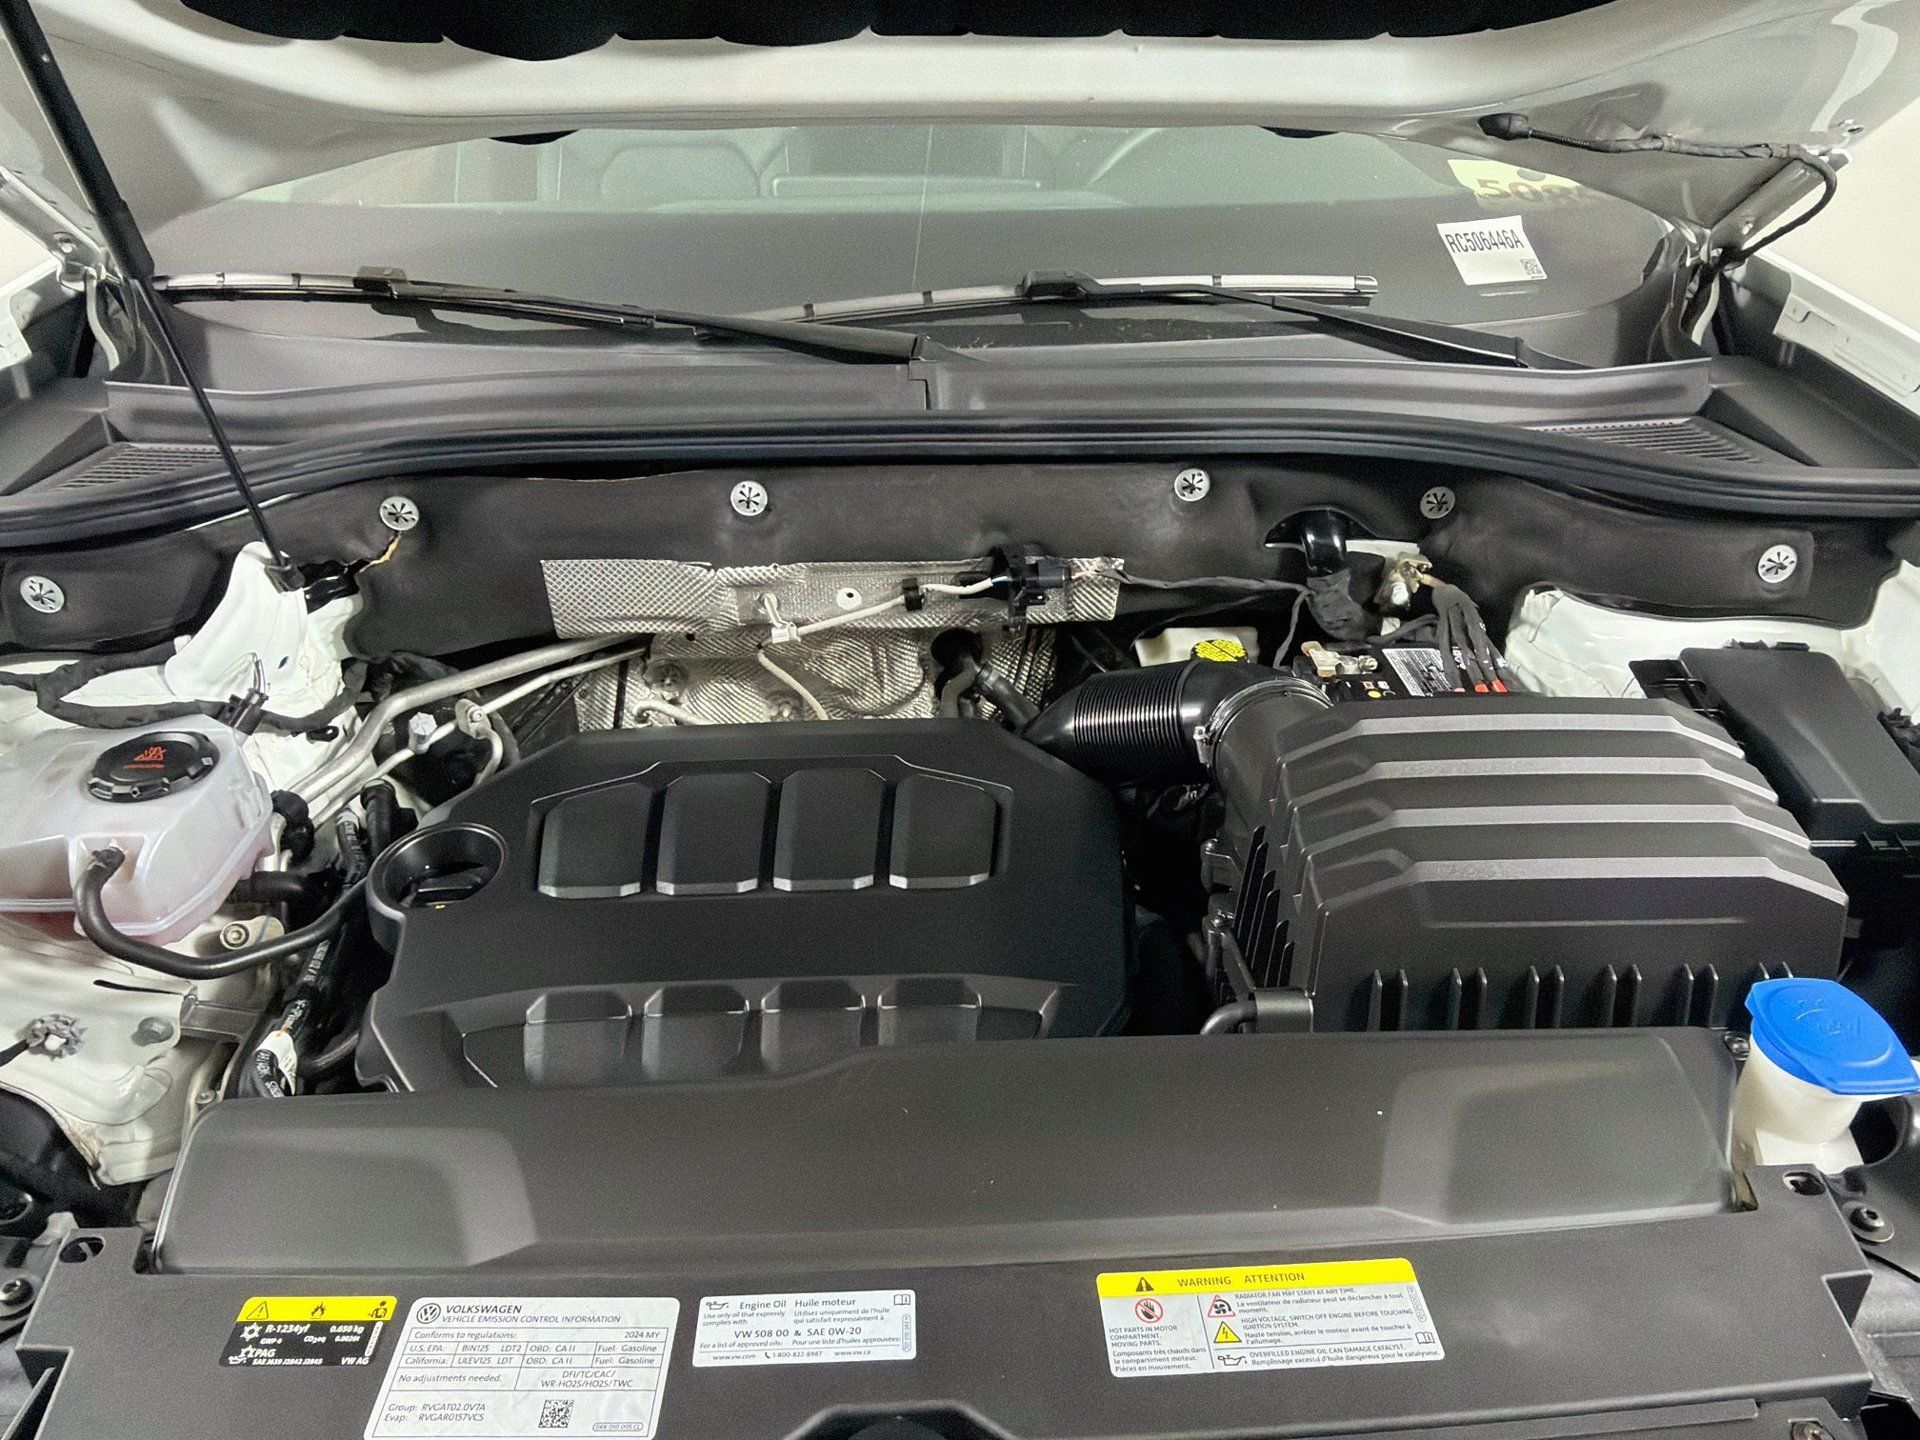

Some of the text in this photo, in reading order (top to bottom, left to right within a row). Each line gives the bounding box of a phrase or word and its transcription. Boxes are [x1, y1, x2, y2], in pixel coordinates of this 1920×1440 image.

[1445, 229, 1525, 253] RC506446A
[1177, 1276, 1232, 1287] WARNING
[1244, 1272, 1305, 1283] ATTENTION
[740, 1300, 787, 1311] Engine Oil
[794, 1298, 856, 1307] Huile moteur
[446, 1305, 523, 1314] VOLKSWAGEN
[755, 1310, 786, 1318] expressly
[819, 1308, 861, 1317] uniquement
[442, 1315, 621, 1323] VEHICLE EMISSION CONTROL INFORMATION
[805, 1316, 832, 1324] satisfait
[832, 1315, 879, 1323] expressément
[265, 1323, 311, 1335] R-1234yf
[353, 1325, 365, 1334] kg
[734, 1326, 862, 1338] VW 508 00 & SAE 0W-20
[414, 1331, 454, 1339] Conforms
[467, 1331, 517, 1340] regulations:
[624, 1331, 660, 1339] 2024 MY
[1110, 1333, 1161, 1341] COMPARTMENT.
[409, 1344, 426, 1352] U.S.
[461, 1344, 490, 1352] BIN125
[500, 1344, 521, 1352] LDT2
[621, 1344, 658, 1352] Gasoline
[1113, 1350, 1153, 1358] Composants
[1167, 1347, 1189, 1355] chauds
[254, 1348, 277, 1358] PAG
[773, 1350, 822, 1358] 1-800-822-8987
[341, 1357, 370, 1365] VW AG
[404, 1357, 448, 1365] California:
[457, 1356, 514, 1365] ULEV125 LDT
[526, 1357, 548, 1365] OBD:
[551, 1357, 564, 1365] CA
[618, 1357, 655, 1365] Gasoline
[1121, 1356, 1170, 1365] compartiment
[1251, 1359, 1294, 1367] Remplissage
[1345, 1354, 1380, 1362] dangereux
[1115, 1364, 1137, 1372] Pièces
[399, 1374, 502, 1384] No adjustments needed.
[562, 1370, 616, 1379] DFI/TC/CAC/
[388, 1403, 418, 1413] Group:
[384, 1413, 409, 1423] Evap:
